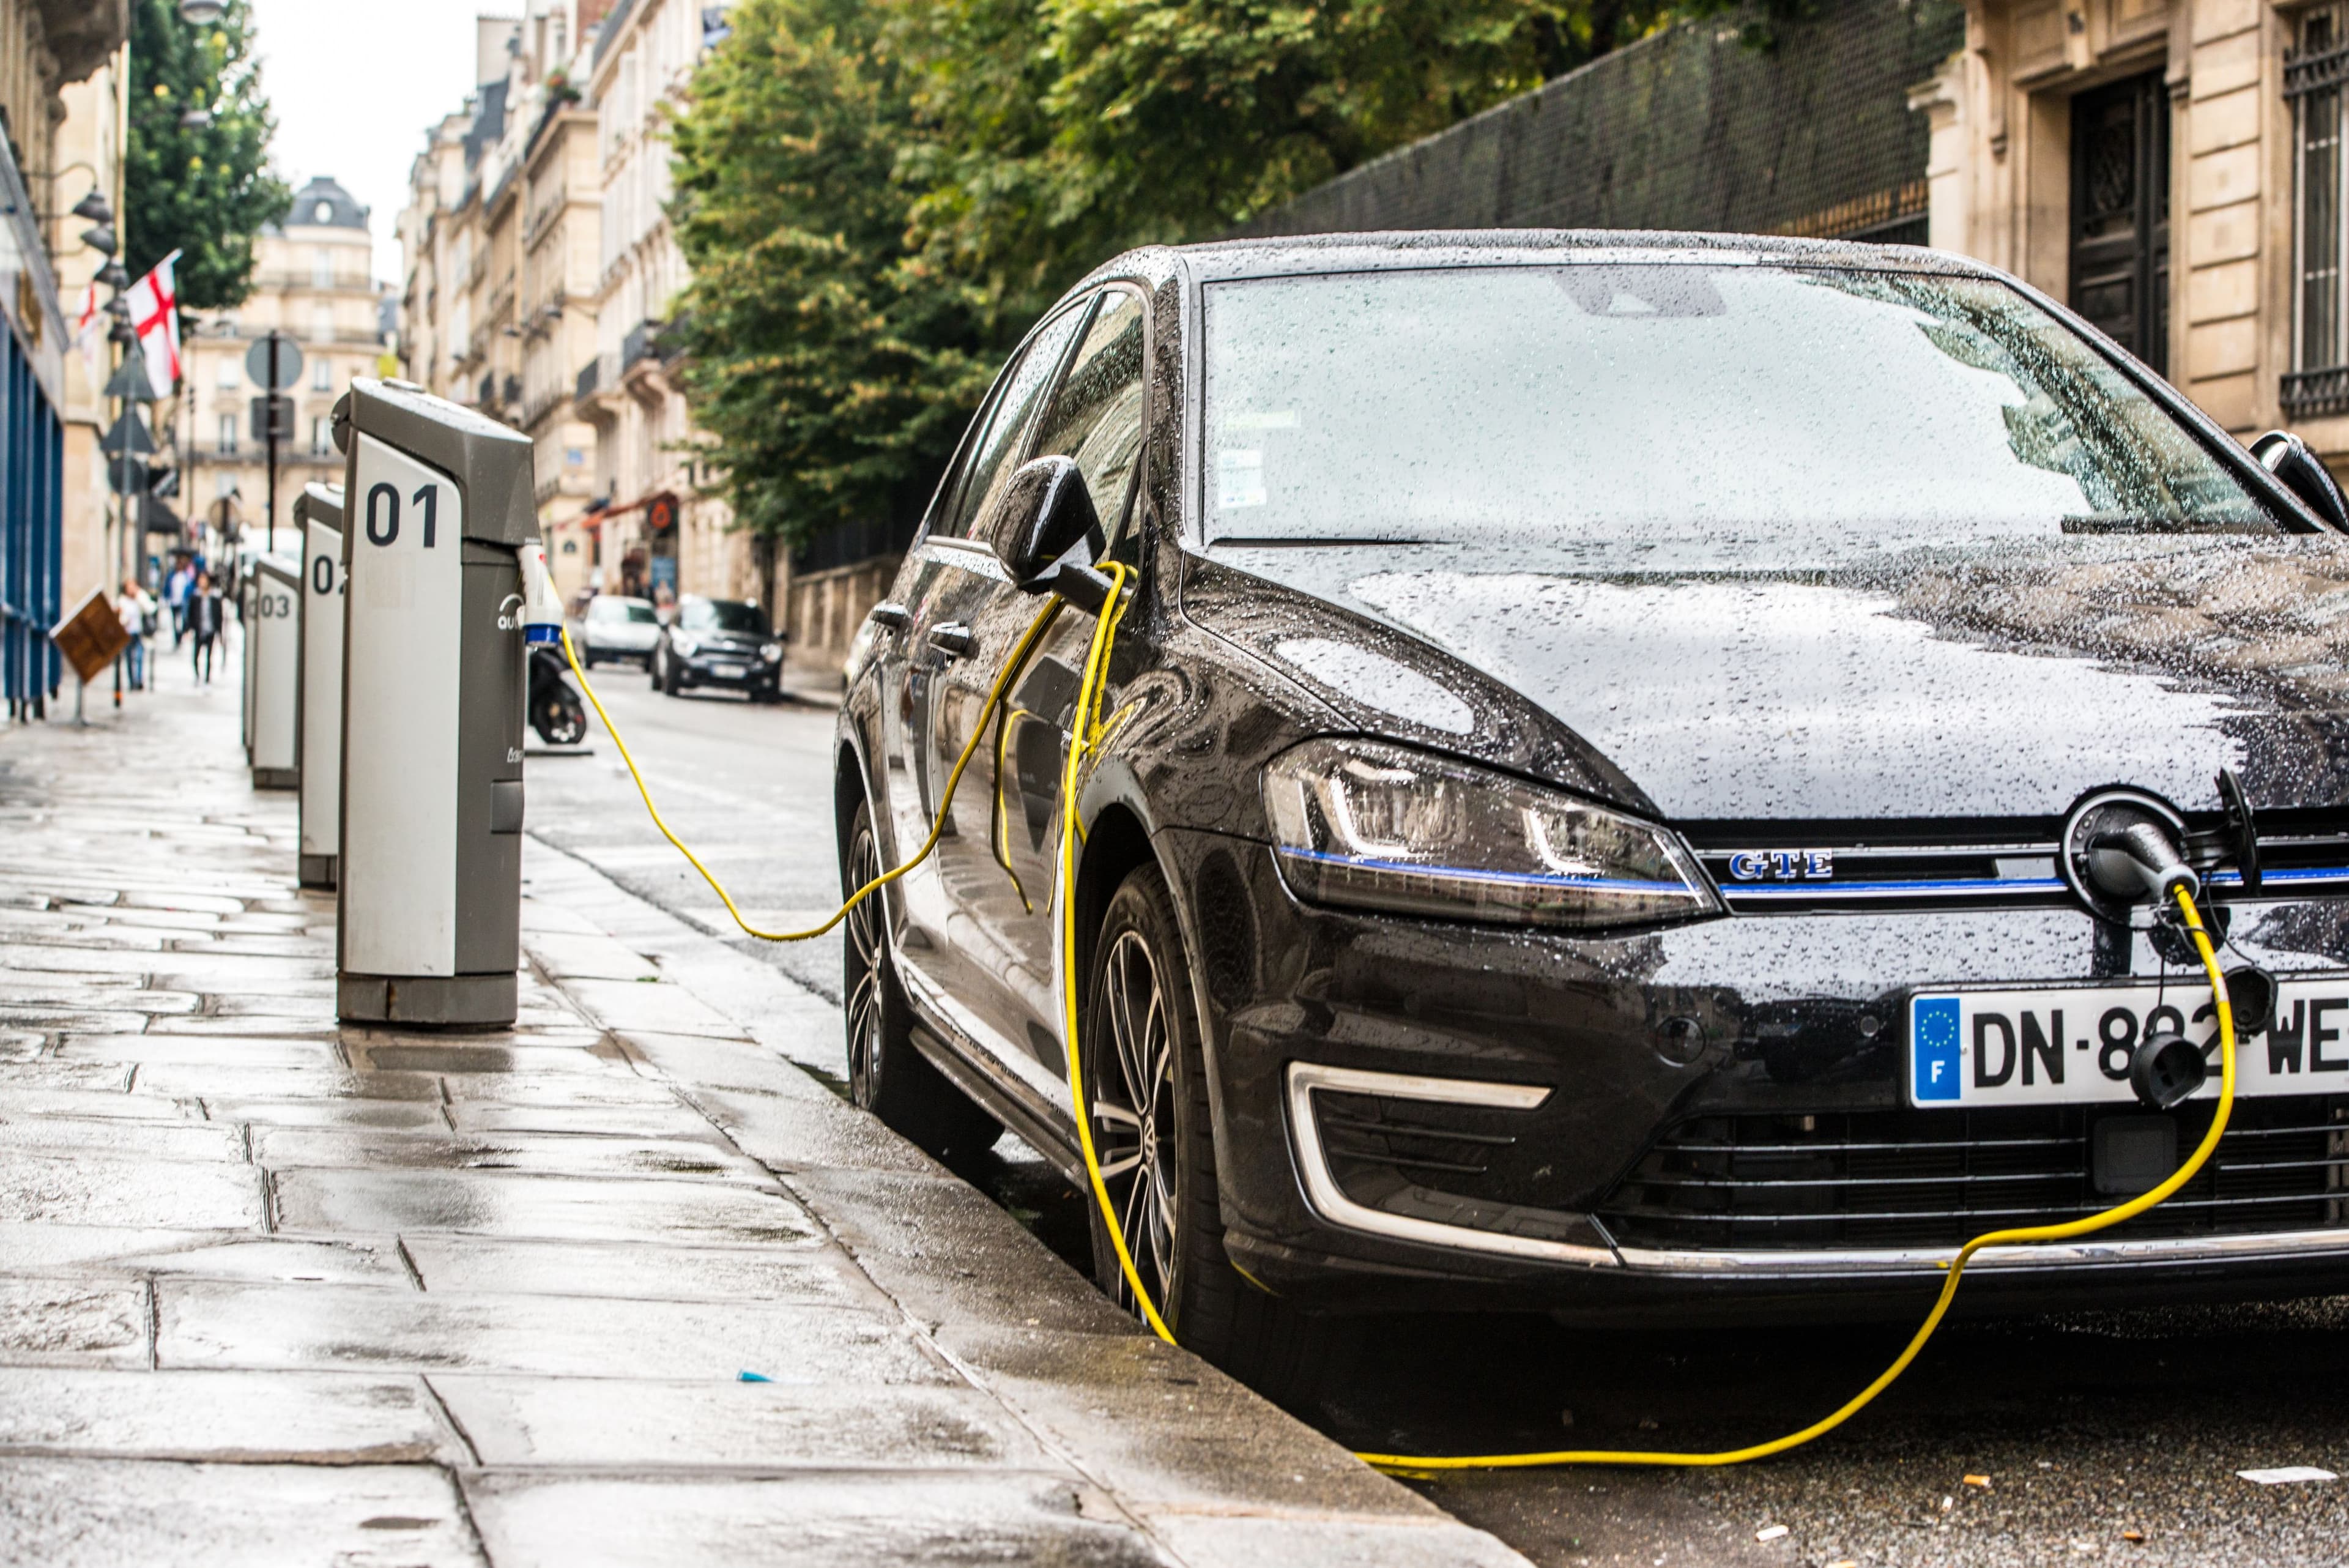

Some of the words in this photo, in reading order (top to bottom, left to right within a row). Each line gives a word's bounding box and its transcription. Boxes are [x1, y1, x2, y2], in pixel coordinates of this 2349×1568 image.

[367, 482, 437, 548] 01
[313, 555, 344, 595] 0
[261, 595, 289, 619] 03
[1729, 847, 1833, 880] GTE
[1931, 1060, 1945, 1083] F
